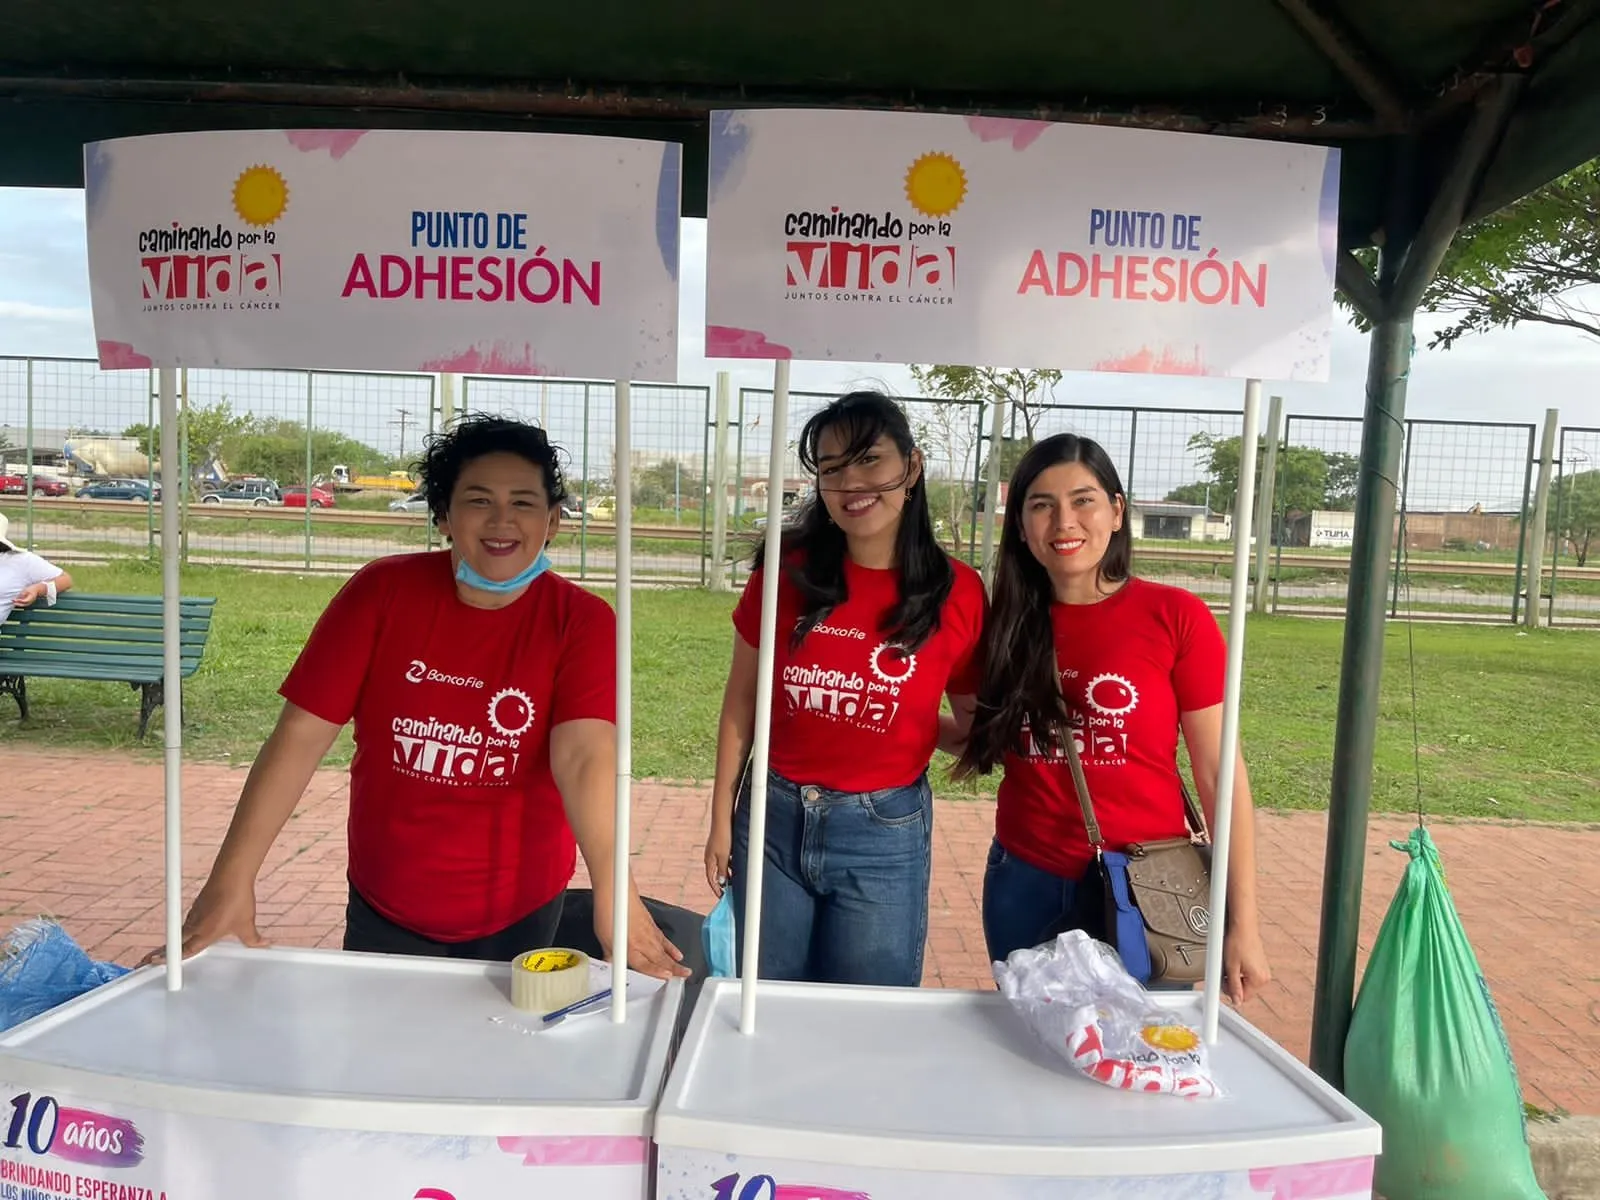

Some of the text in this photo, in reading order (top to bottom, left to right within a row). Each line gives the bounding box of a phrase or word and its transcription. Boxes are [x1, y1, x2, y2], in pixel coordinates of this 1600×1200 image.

[139, 221, 276, 252] caminando por la
[411, 211, 528, 250] PUNTO DE
[785, 206, 951, 240] caminando por la
[1089, 208, 1202, 251] PUNTO DE
[341, 245, 601, 306] ADHESIÓN
[1016, 247, 1268, 308] ADHESIÓN
[142, 300, 281, 312] JUNTOS CONTRA EL CÁNCER
[784, 292, 829, 301] JUNTOS
[835, 293, 882, 303] CONTRA
[908, 294, 953, 305] CÁNCER
[783, 664, 900, 697] caminando por la
[392, 716, 520, 749] caminando por la
[1089, 716, 1111, 729] por
[1113, 717, 1125, 729] la
[4, 1091, 124, 1155] 10 años
[0, 1158, 153, 1200] BRINDANDO ESPERANZA
[1, 1182, 19, 1200] LOS
